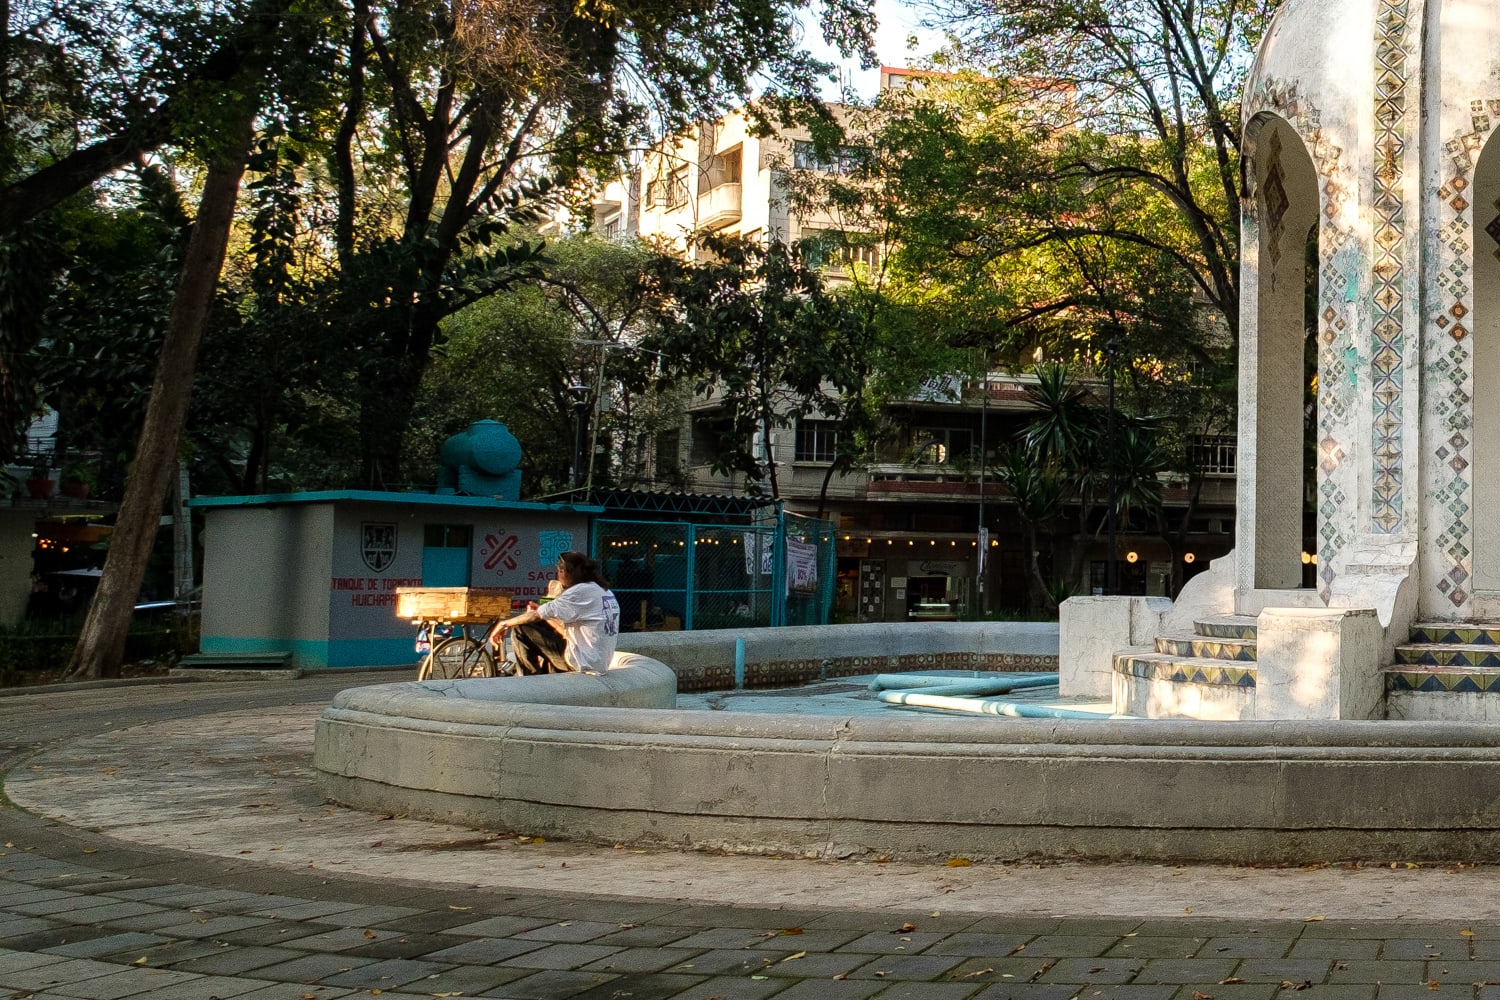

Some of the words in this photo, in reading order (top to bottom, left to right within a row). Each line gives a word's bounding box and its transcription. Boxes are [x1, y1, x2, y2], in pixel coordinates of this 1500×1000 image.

[528, 571, 558, 581] SAC
[332, 578, 364, 590] TANQUE
[368, 578, 378, 590] DE
[383, 578, 422, 590] TORMENTA
[352, 594, 397, 606] HUICHAPA
